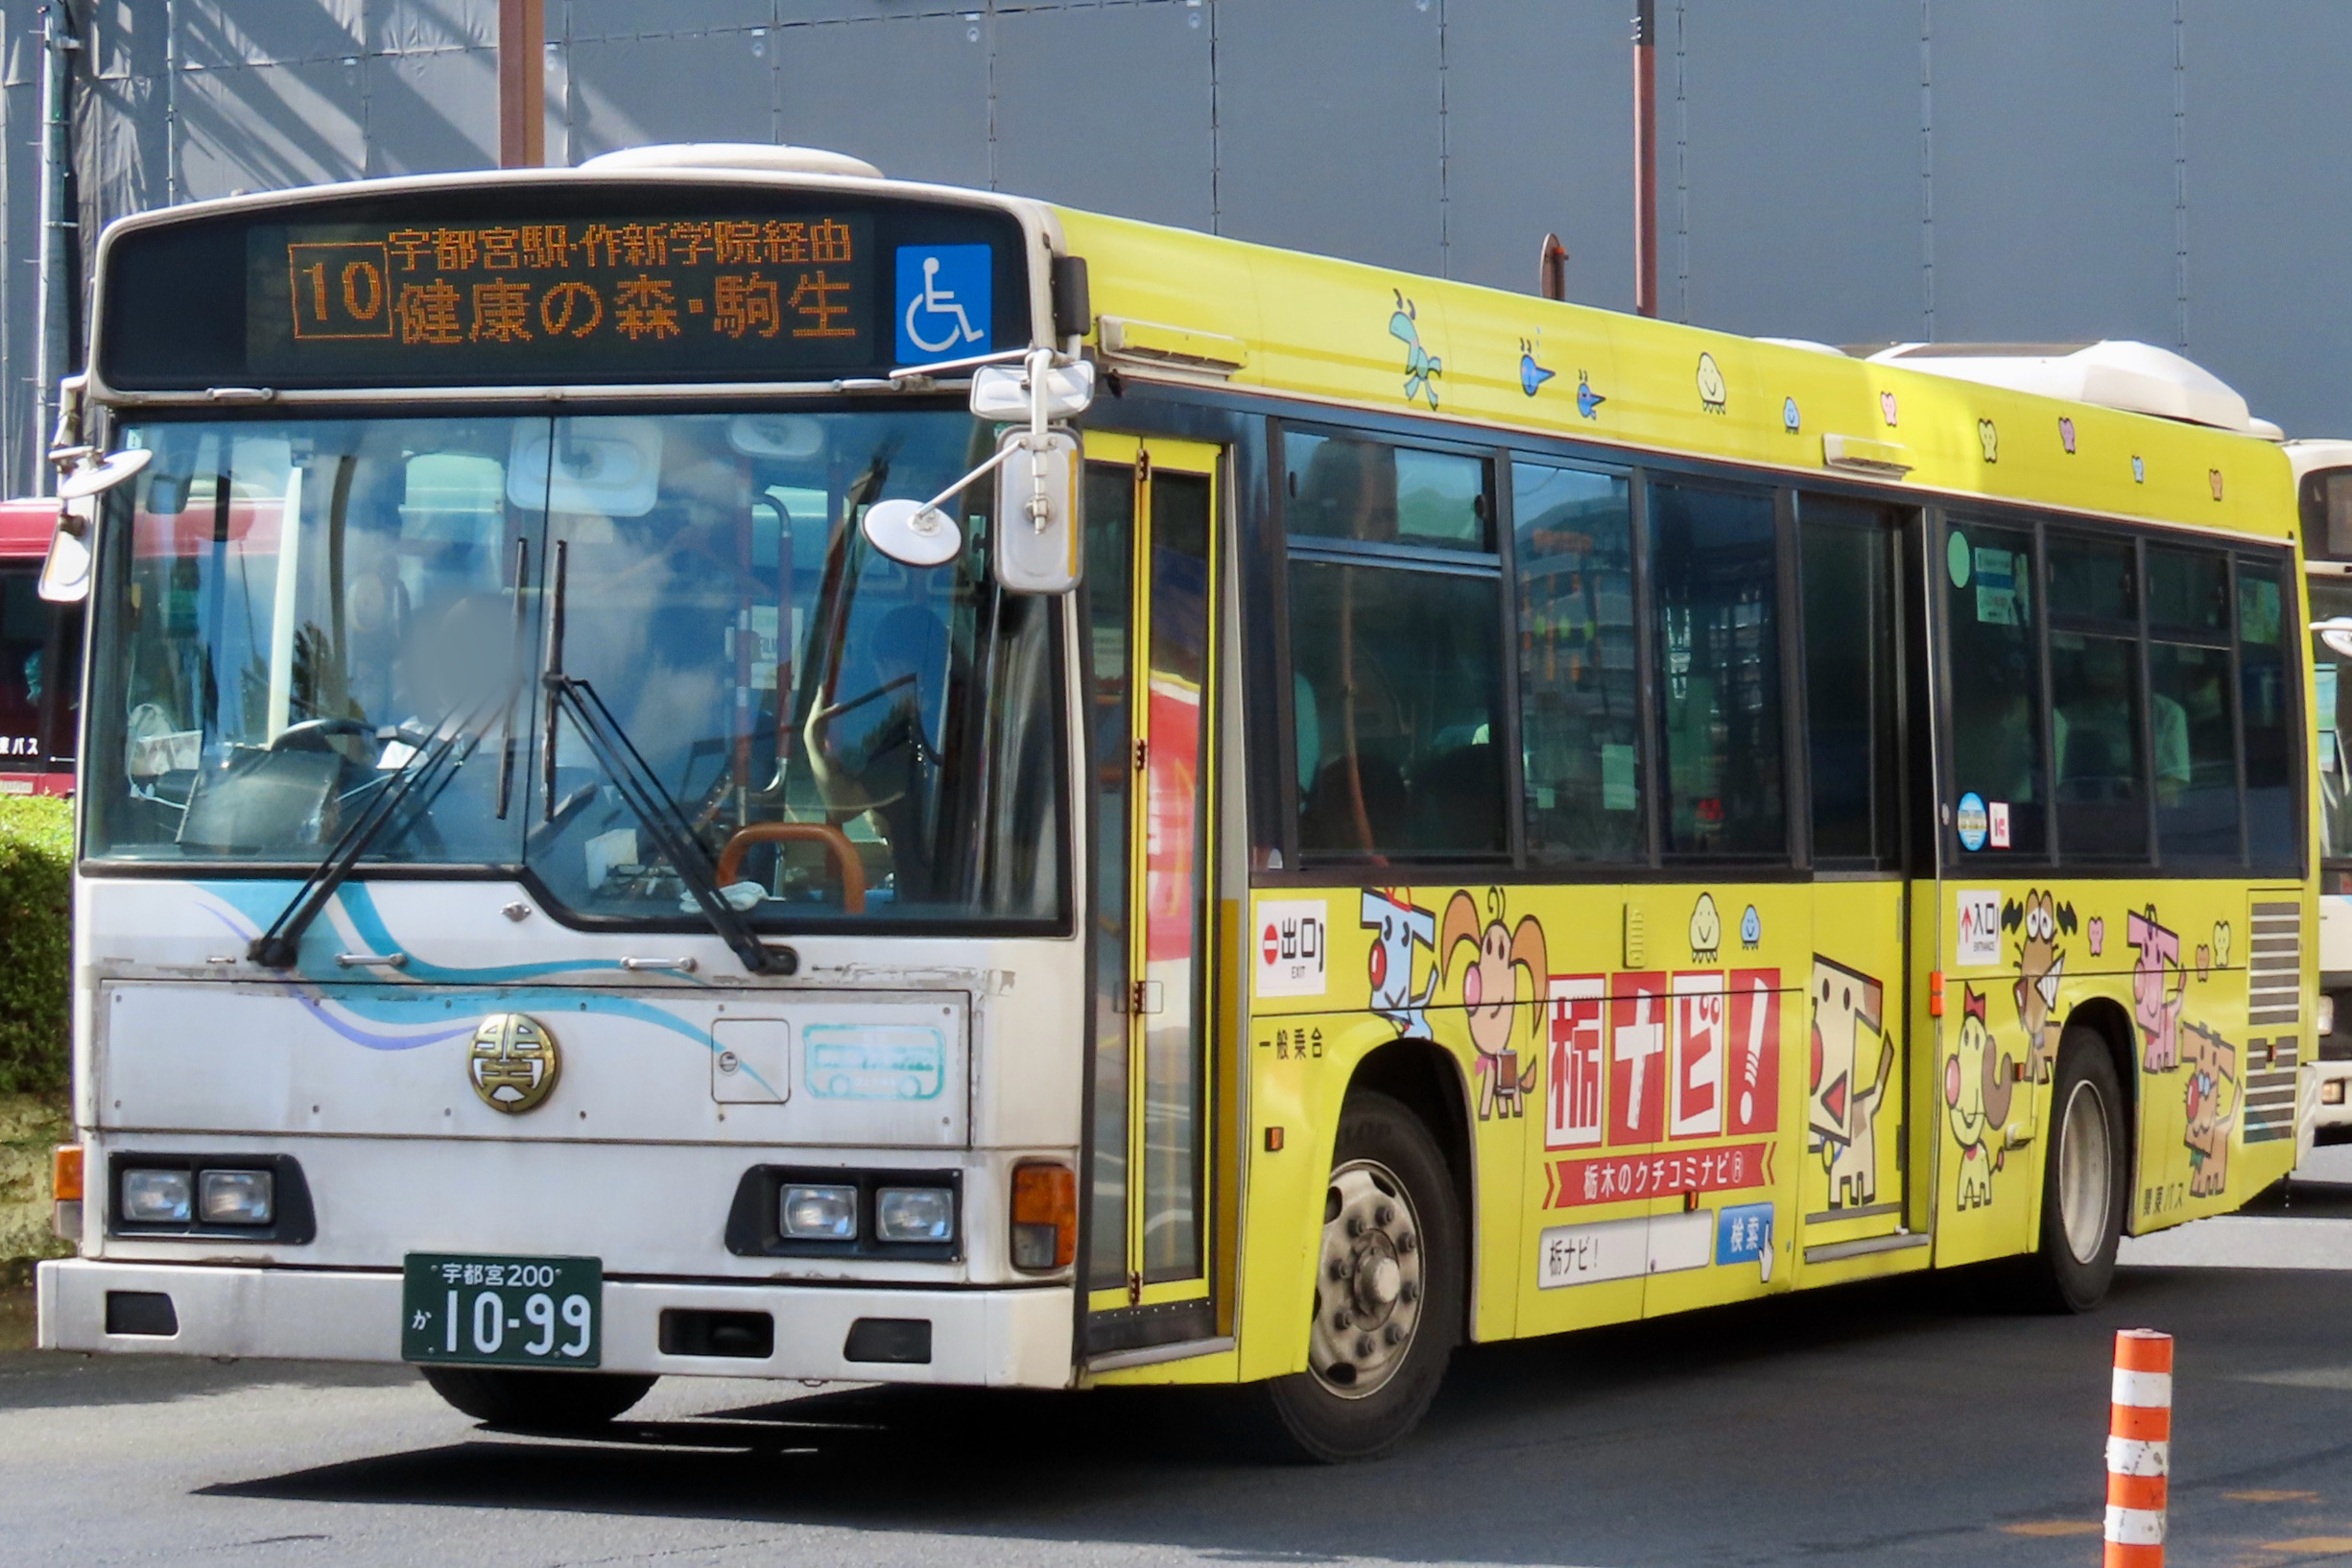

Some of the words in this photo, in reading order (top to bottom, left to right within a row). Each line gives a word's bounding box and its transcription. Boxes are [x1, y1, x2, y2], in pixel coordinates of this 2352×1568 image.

[302, 261, 381, 321] 10
[394, 272, 856, 343] 健康の森・駒生
[1281, 917, 1317, 959] 出口
[1973, 903, 1995, 936] 入口
[1291, 965, 1307, 980] EXIT
[1258, 1027, 1323, 1060] 一般乗合
[1730, 1215, 1760, 1253] 検索
[412, 1309, 432, 1331] か
[446, 1290, 591, 1358] 10-99
